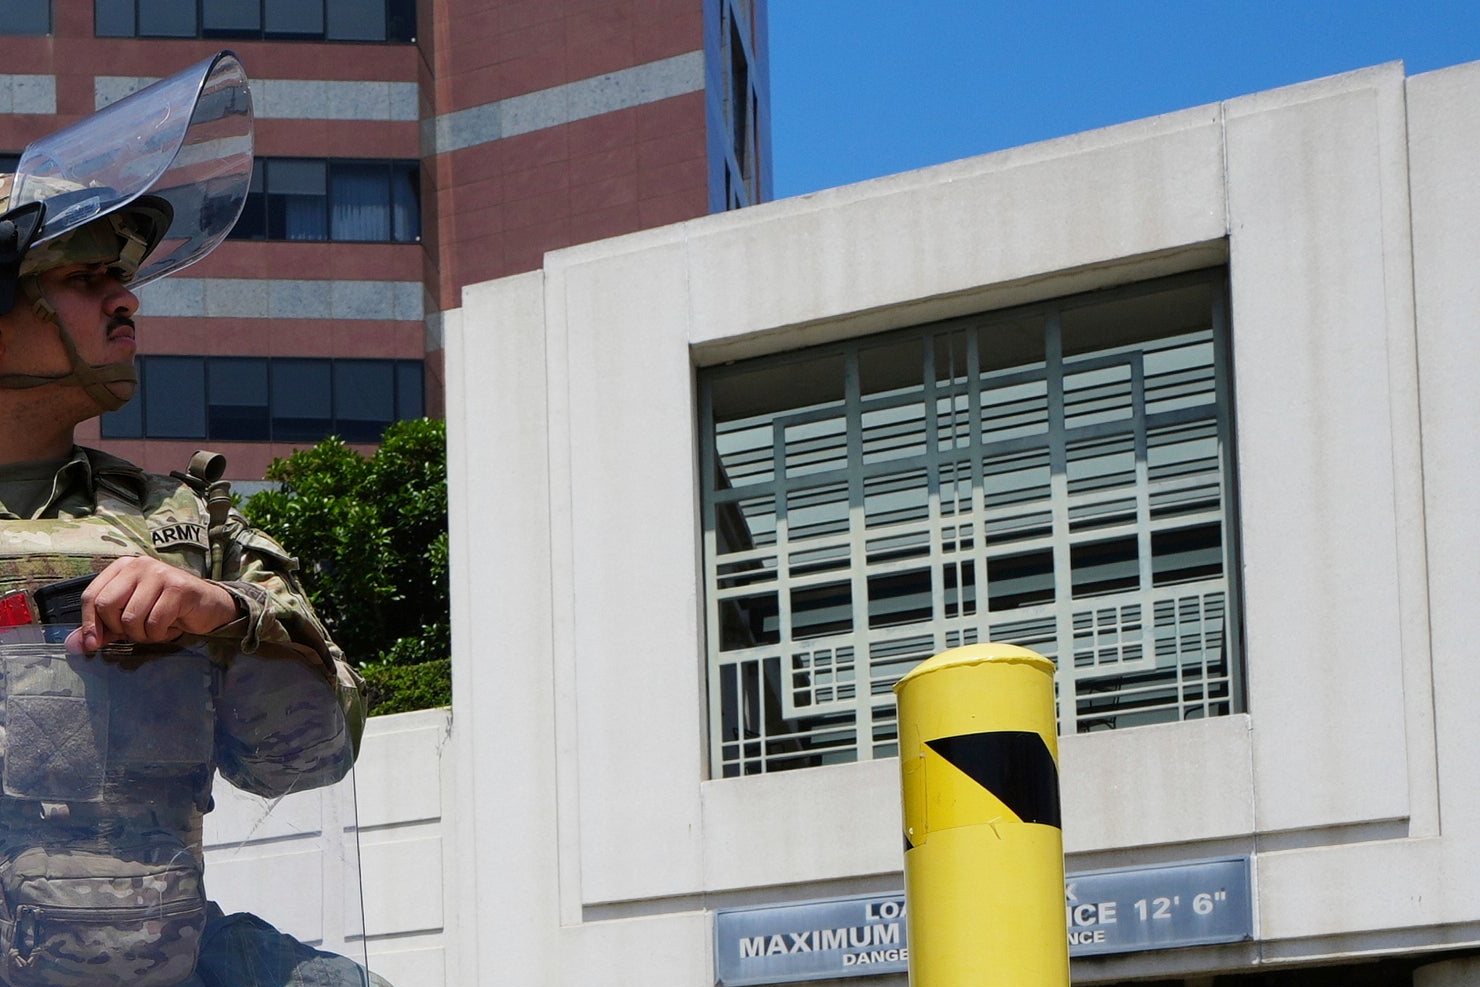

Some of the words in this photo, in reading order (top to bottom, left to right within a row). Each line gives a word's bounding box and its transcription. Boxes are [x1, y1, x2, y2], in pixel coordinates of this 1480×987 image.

[151, 525, 201, 545] ARMY
[739, 922, 900, 959] MAXIMUM
[1134, 895, 1180, 921] 12'
[1192, 890, 1227, 915] 6"
